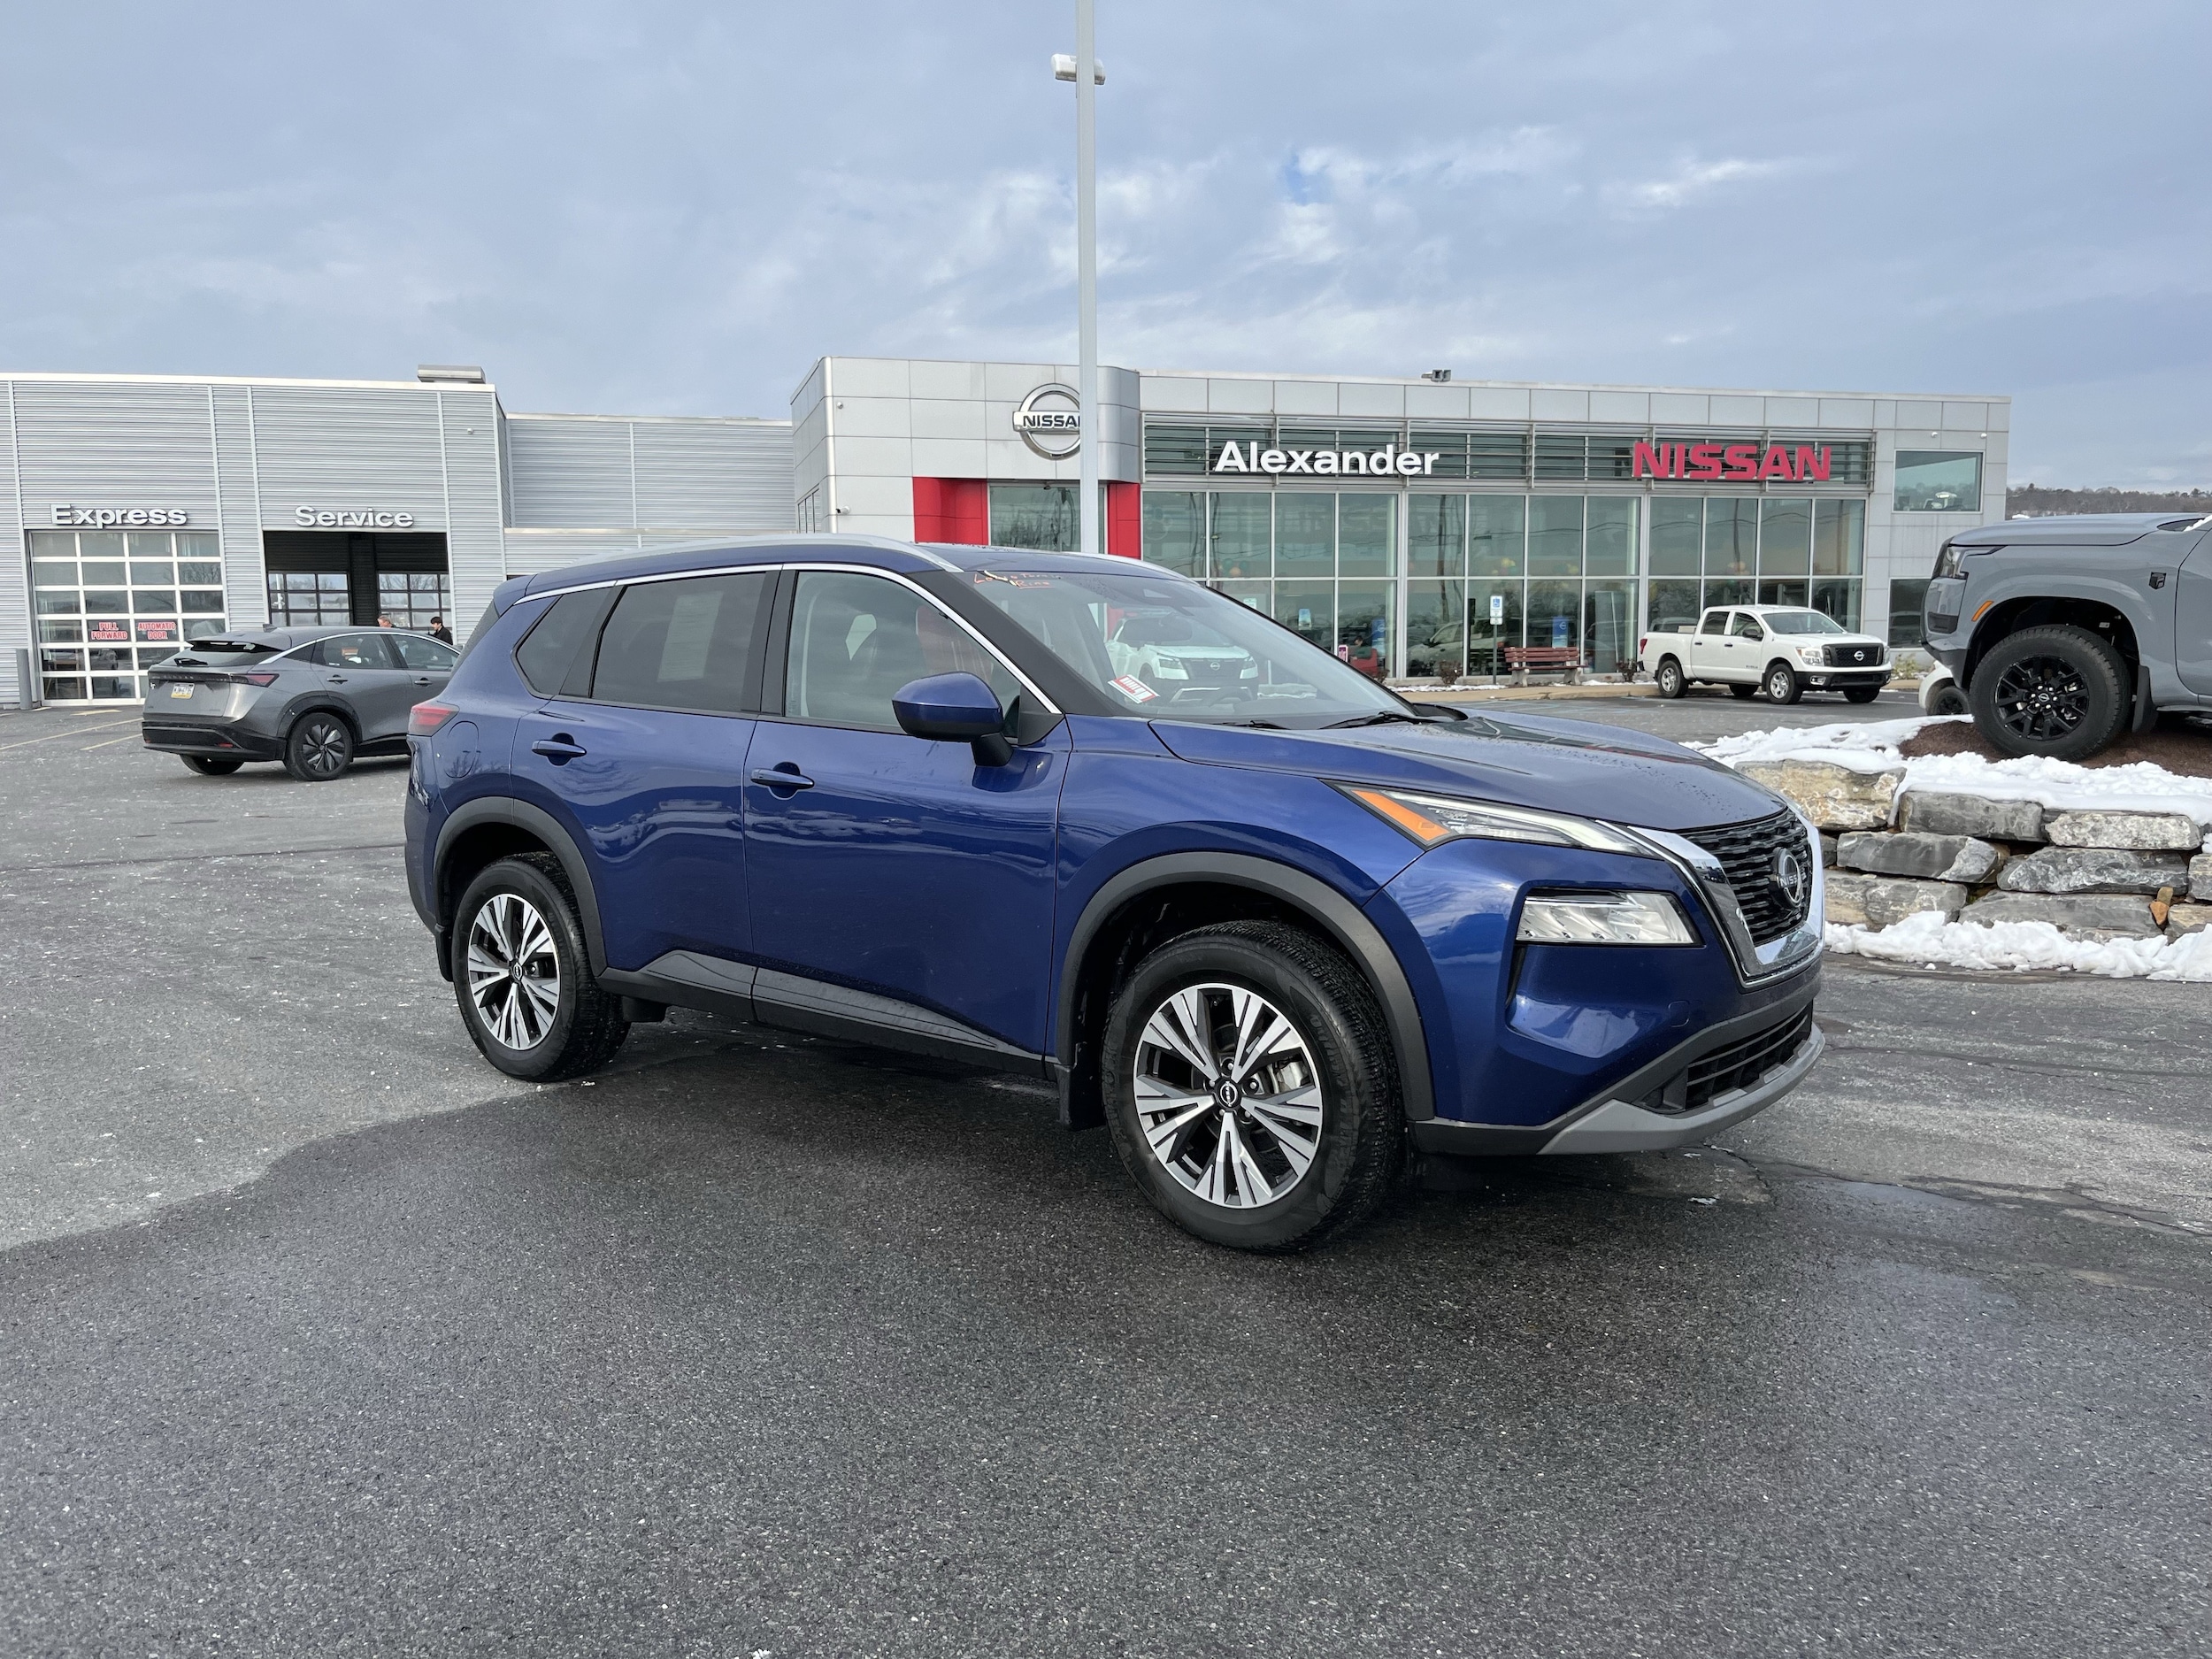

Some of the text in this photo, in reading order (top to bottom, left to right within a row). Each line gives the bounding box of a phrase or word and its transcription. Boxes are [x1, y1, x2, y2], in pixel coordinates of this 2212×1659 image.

[1214, 441, 1440, 476] Alexander
[1632, 440, 1832, 481] NISSAN
[50, 503, 188, 529] Express
[295, 505, 414, 527] Service
[99, 622, 119, 631] PULL
[137, 621, 176, 631] AUTOMATIC
[91, 631, 128, 640] FORWARD
[148, 631, 168, 640] DOOR
